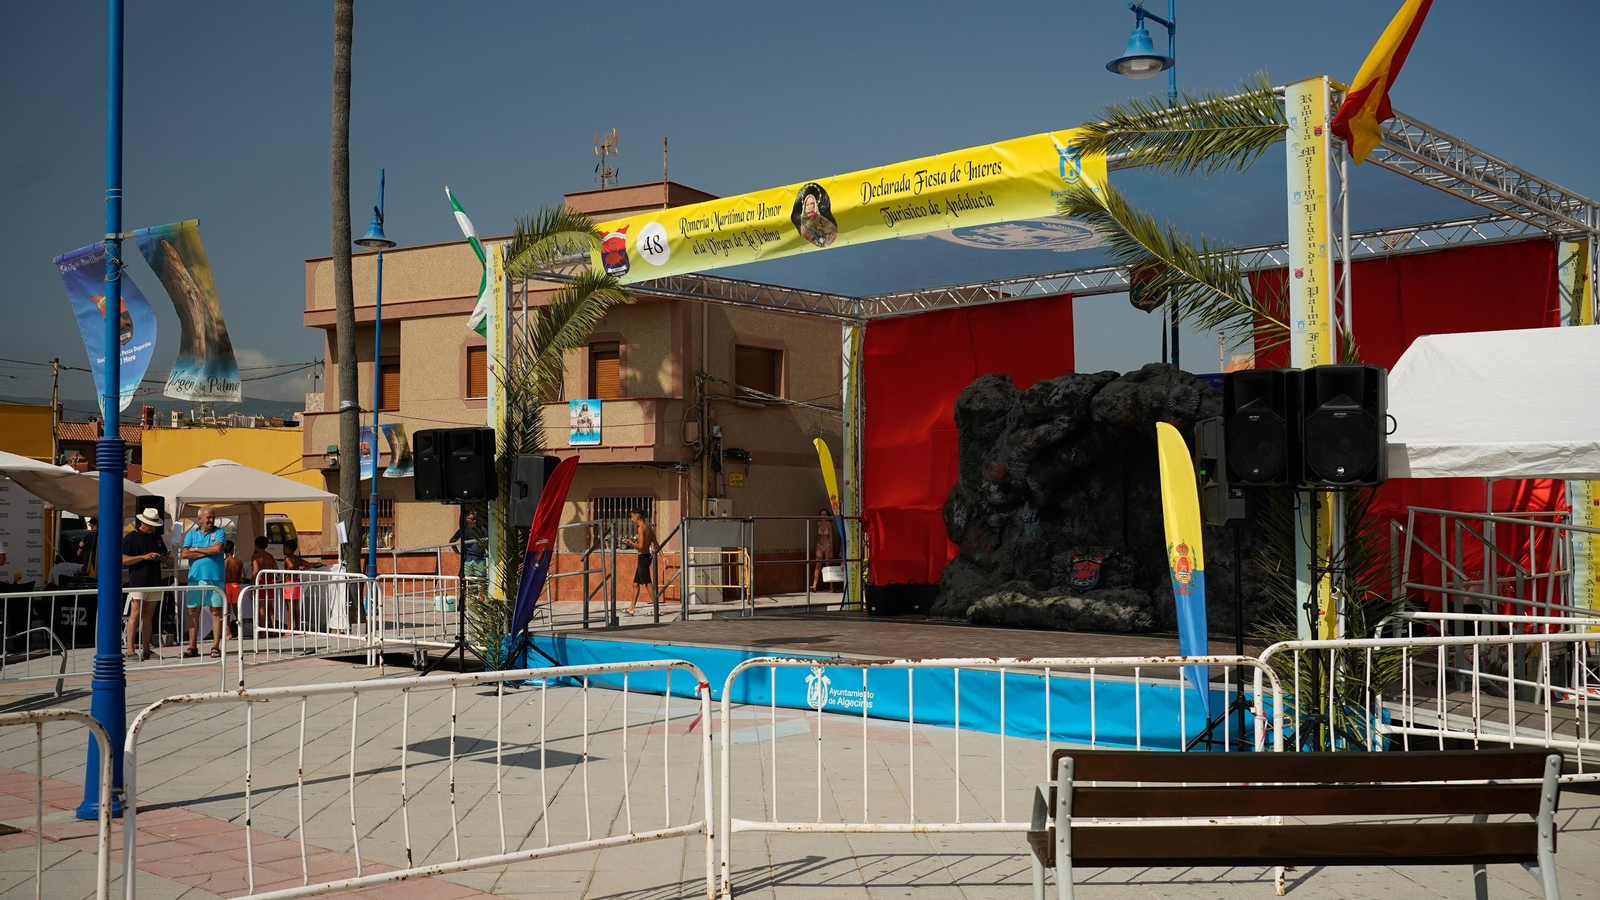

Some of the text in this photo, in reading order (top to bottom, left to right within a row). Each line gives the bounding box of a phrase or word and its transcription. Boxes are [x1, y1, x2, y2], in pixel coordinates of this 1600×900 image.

[860, 160, 1002, 205] Declarada Fiesta de Interes
[745, 209, 755, 222] en
[757, 203, 782, 221] Honor
[879, 203, 928, 228] Turistico
[929, 199, 942, 215] de
[643, 234, 664, 256] 48
[697, 239, 707, 255] la
[705, 237, 735, 257] Virgen
[732, 233, 744, 247] de
[753, 228, 782, 248] Palma
[1306, 286, 1319, 326] Palma
[1305, 332, 1320, 367] Fies
[207, 375, 240, 393] Palma
[828, 697, 873, 708] de Algecirs
[829, 687, 875, 699] Ayuntamieto
